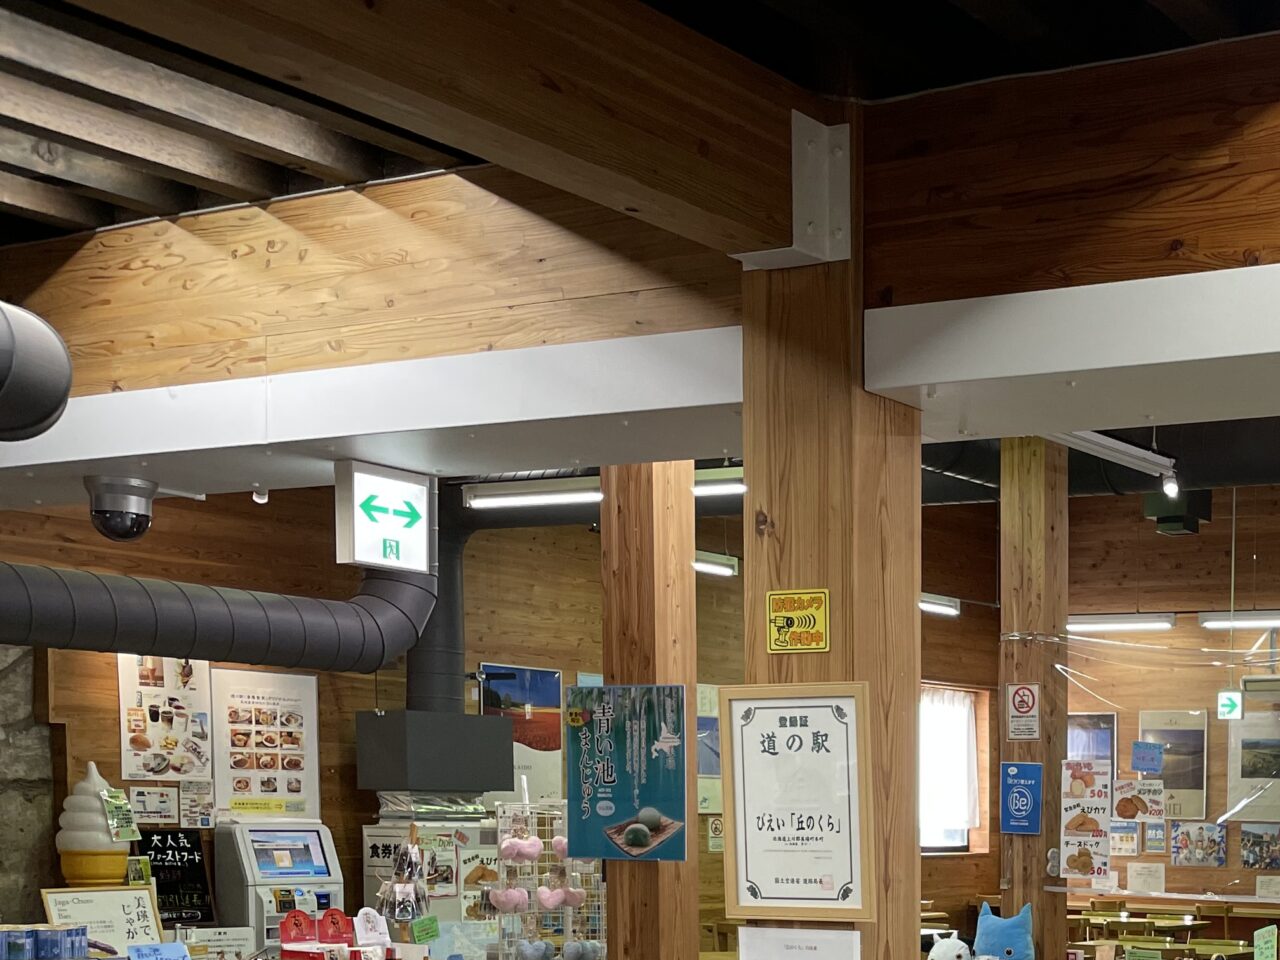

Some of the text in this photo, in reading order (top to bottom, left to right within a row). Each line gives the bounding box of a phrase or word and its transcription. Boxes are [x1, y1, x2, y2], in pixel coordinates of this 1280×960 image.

[788, 631, 824, 647] 作動中
[779, 715, 809, 728] 登録証
[593, 703, 617, 786] 青い池
[760, 730, 831, 756] 道の駅
[579, 727, 594, 820] まんじゅう
[1080, 806, 1107, 814] えびカツ
[151, 833, 191, 848] 大人気
[147, 851, 202, 863] ファーストフード
